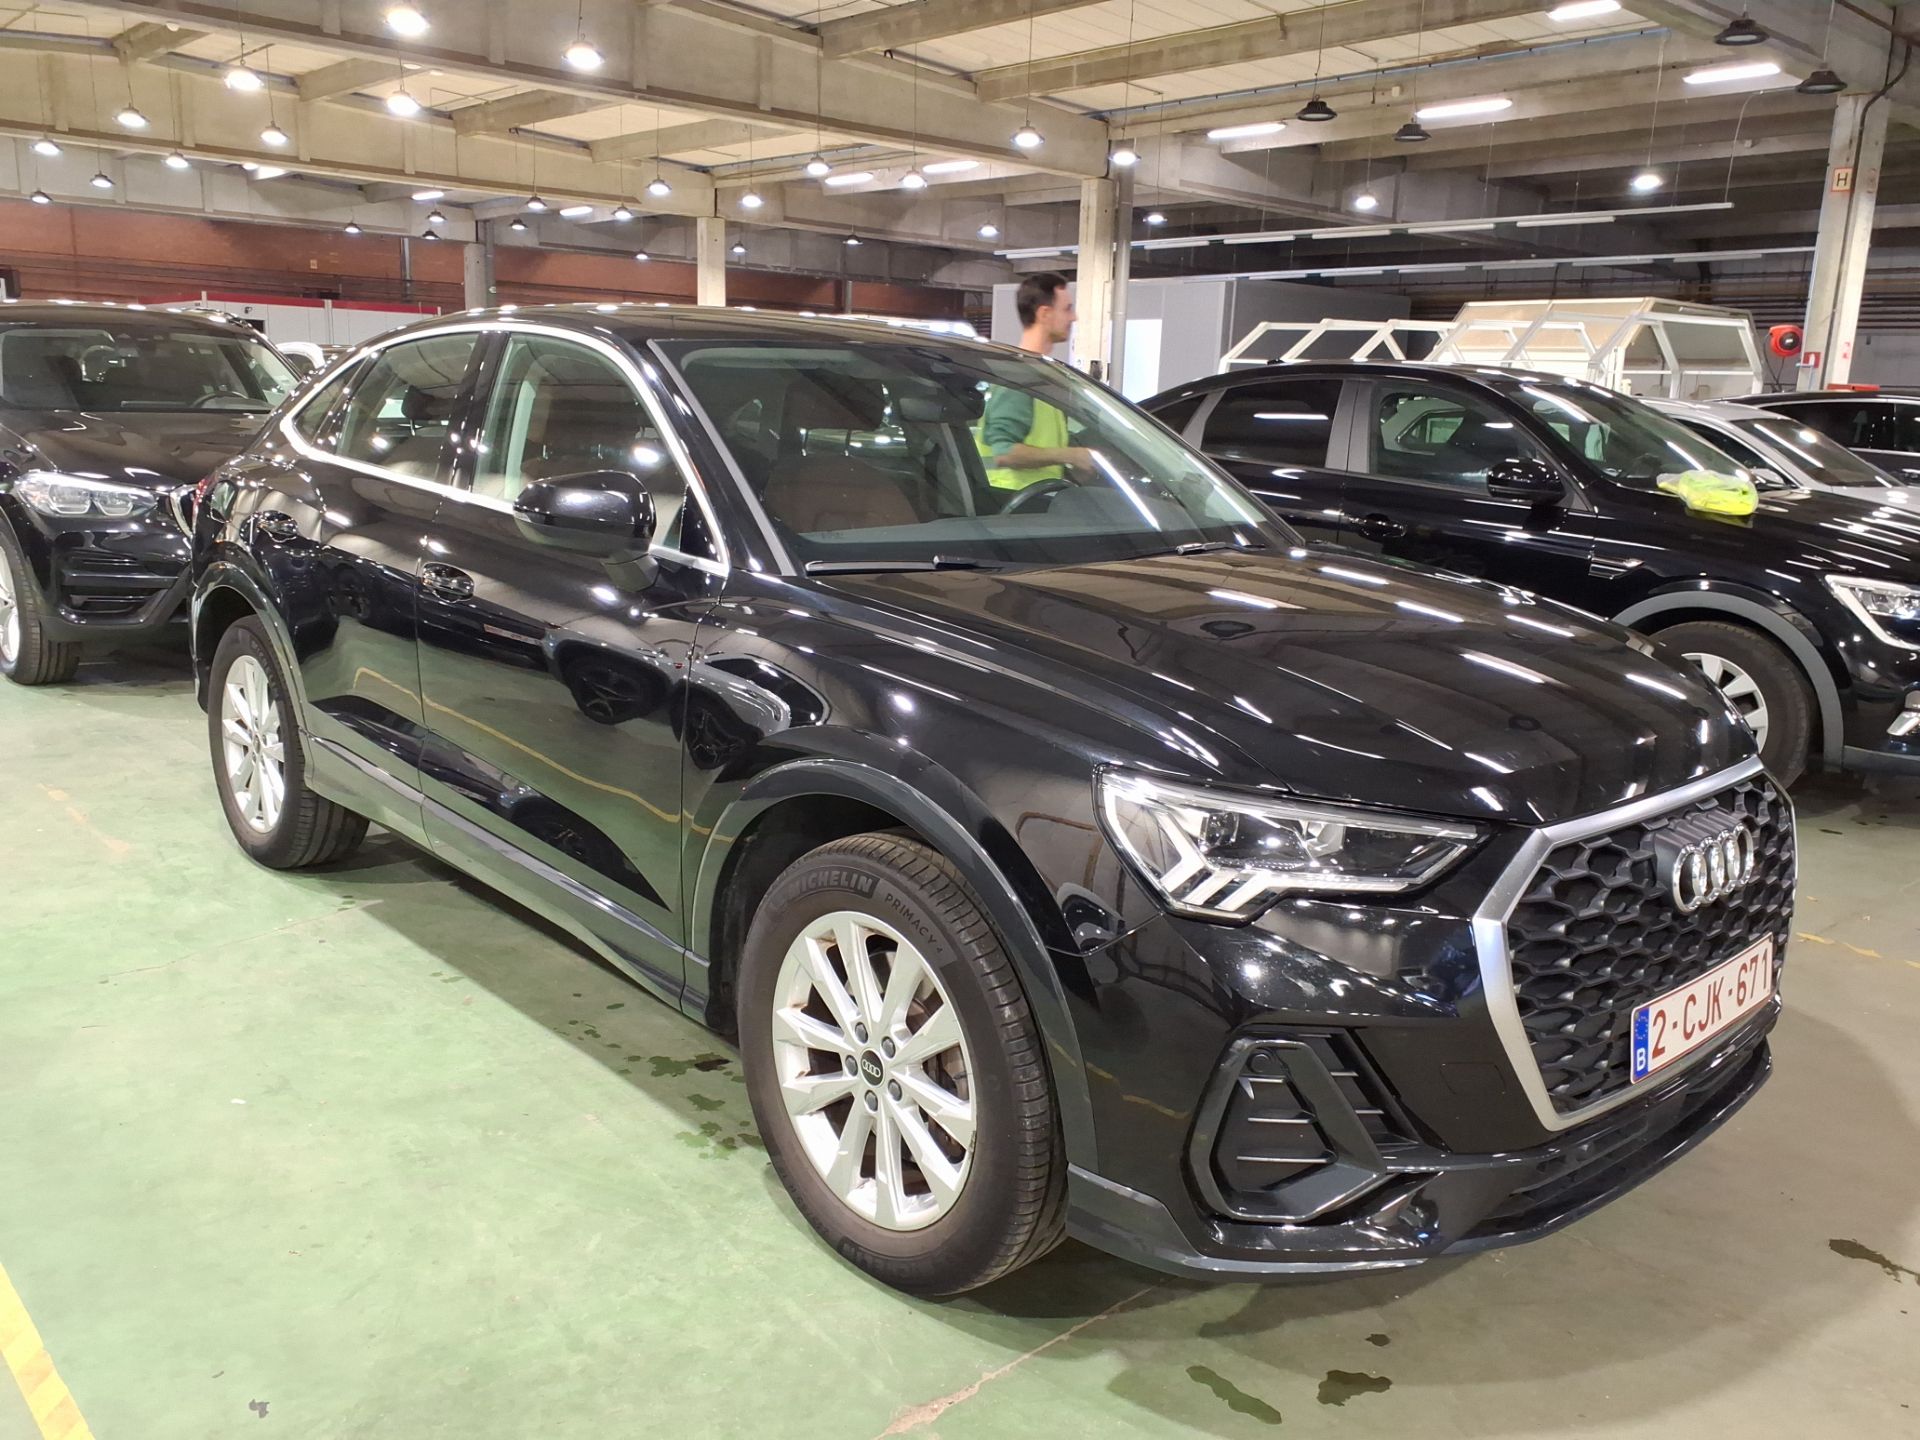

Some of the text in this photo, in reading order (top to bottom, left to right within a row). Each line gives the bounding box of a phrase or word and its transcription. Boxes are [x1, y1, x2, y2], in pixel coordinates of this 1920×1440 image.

[1836, 172, 1848, 187] H
[884, 893, 937, 943] PRIMACY
[1652, 948, 1768, 1059] 2-CJK-671
[1636, 1047, 1646, 1071] B
